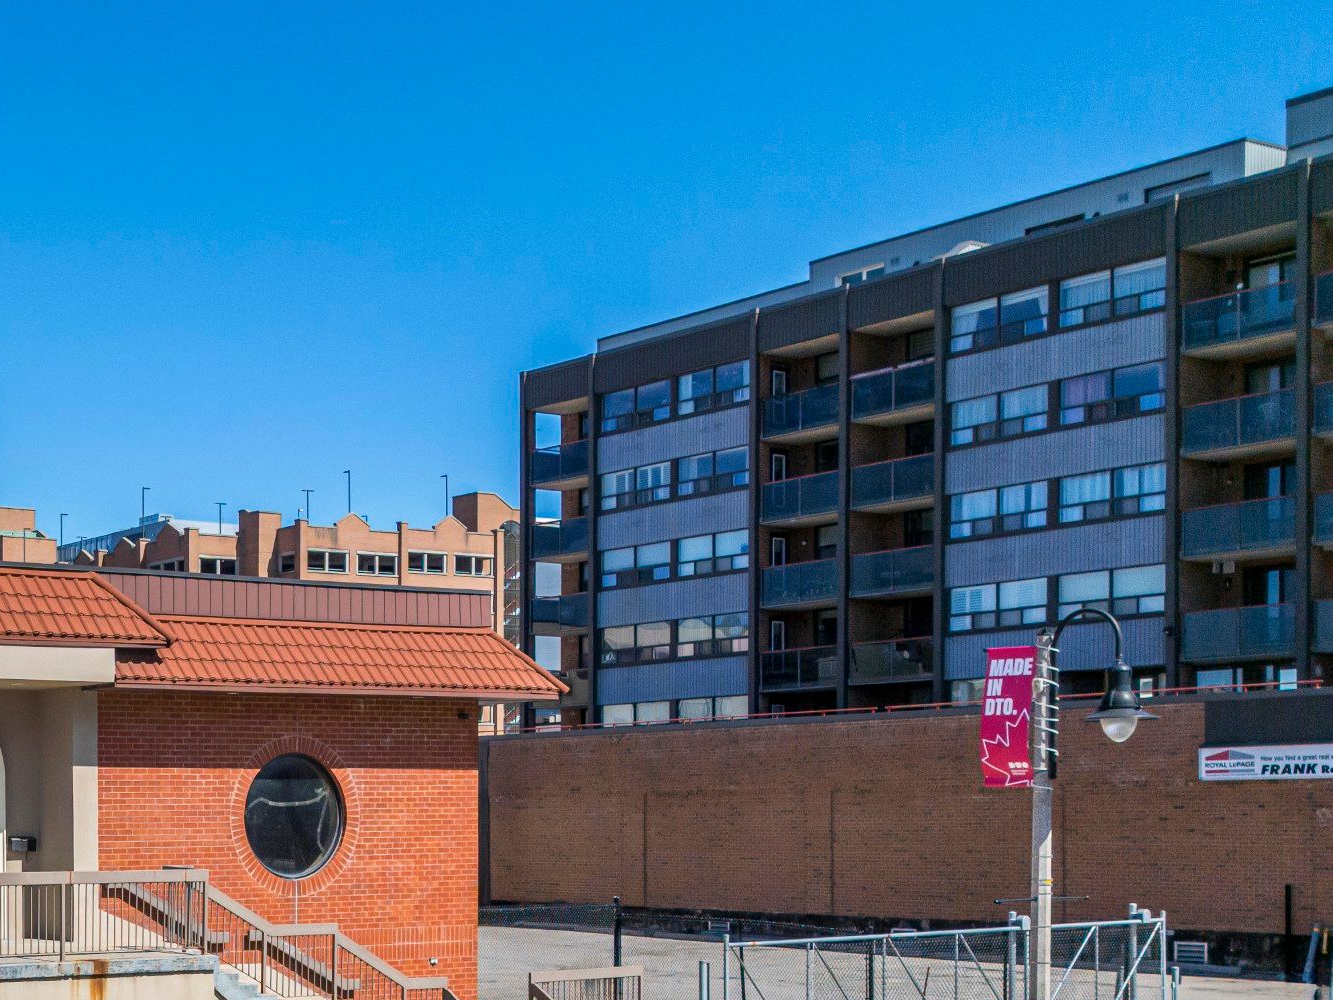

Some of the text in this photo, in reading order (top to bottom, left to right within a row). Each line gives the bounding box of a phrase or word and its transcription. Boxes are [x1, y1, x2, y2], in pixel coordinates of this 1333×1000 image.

[989, 657, 1034, 677] MADE
[986, 678, 1003, 696] IN
[984, 698, 1018, 716] DTO.
[1261, 763, 1318, 775] FRANK
